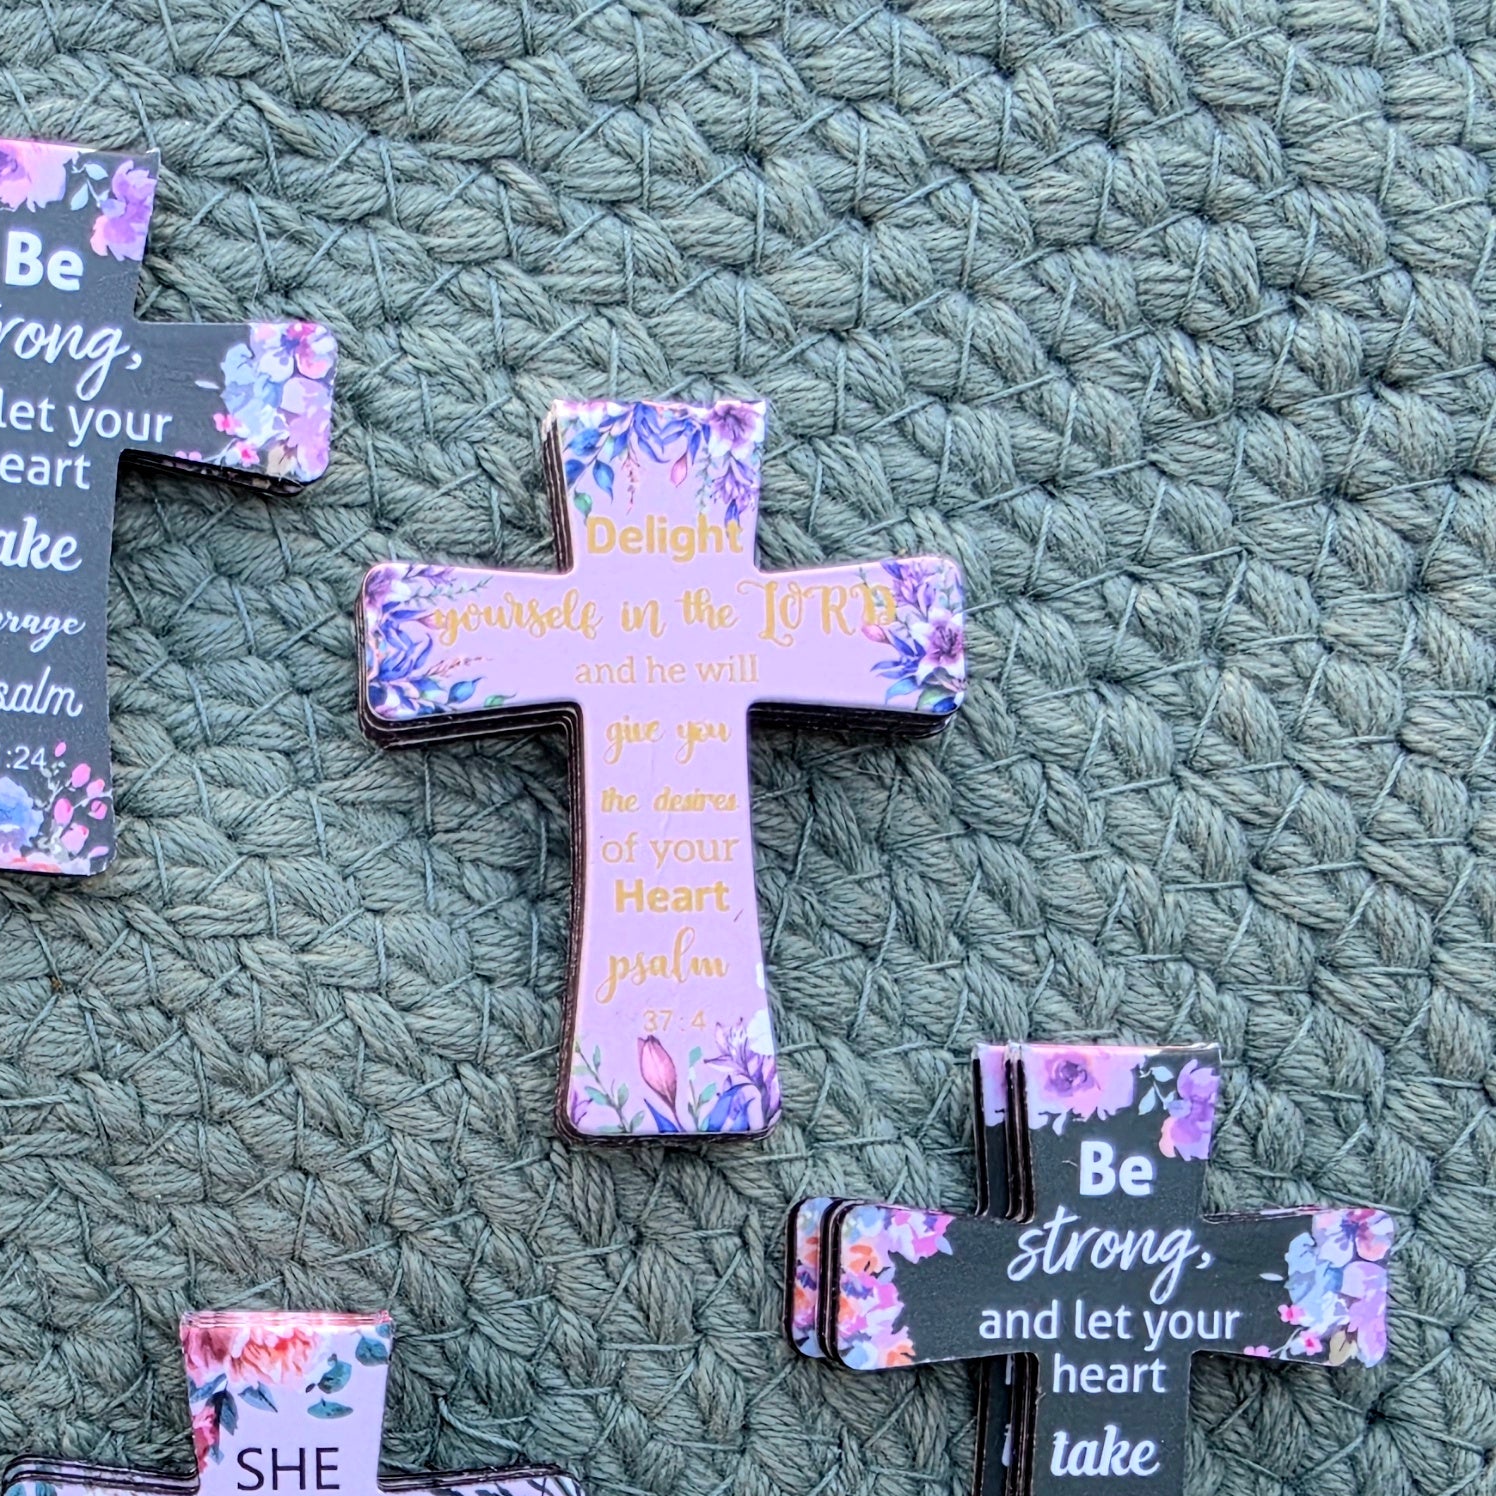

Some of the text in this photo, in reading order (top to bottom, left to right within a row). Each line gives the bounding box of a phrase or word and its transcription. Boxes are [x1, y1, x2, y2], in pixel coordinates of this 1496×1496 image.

[4, 230, 85, 291] Be
[67, 405, 173, 447] your
[586, 515, 745, 563] Delight
[431, 577, 899, 648] yourself in the LORD
[575, 655, 760, 685] and he will
[602, 714, 732, 764] give you
[600, 786, 740, 813] the desires
[601, 835, 740, 869] of your
[594, 925, 730, 1003] psalm
[1078, 1141, 1154, 1197] Be
[1006, 1204, 1214, 1305] strong,
[979, 1300, 1241, 1349] and let your
[1052, 1353, 1166, 1394] heart
[236, 1447, 341, 1492] SHE
[1049, 1423, 1160, 1477] take
